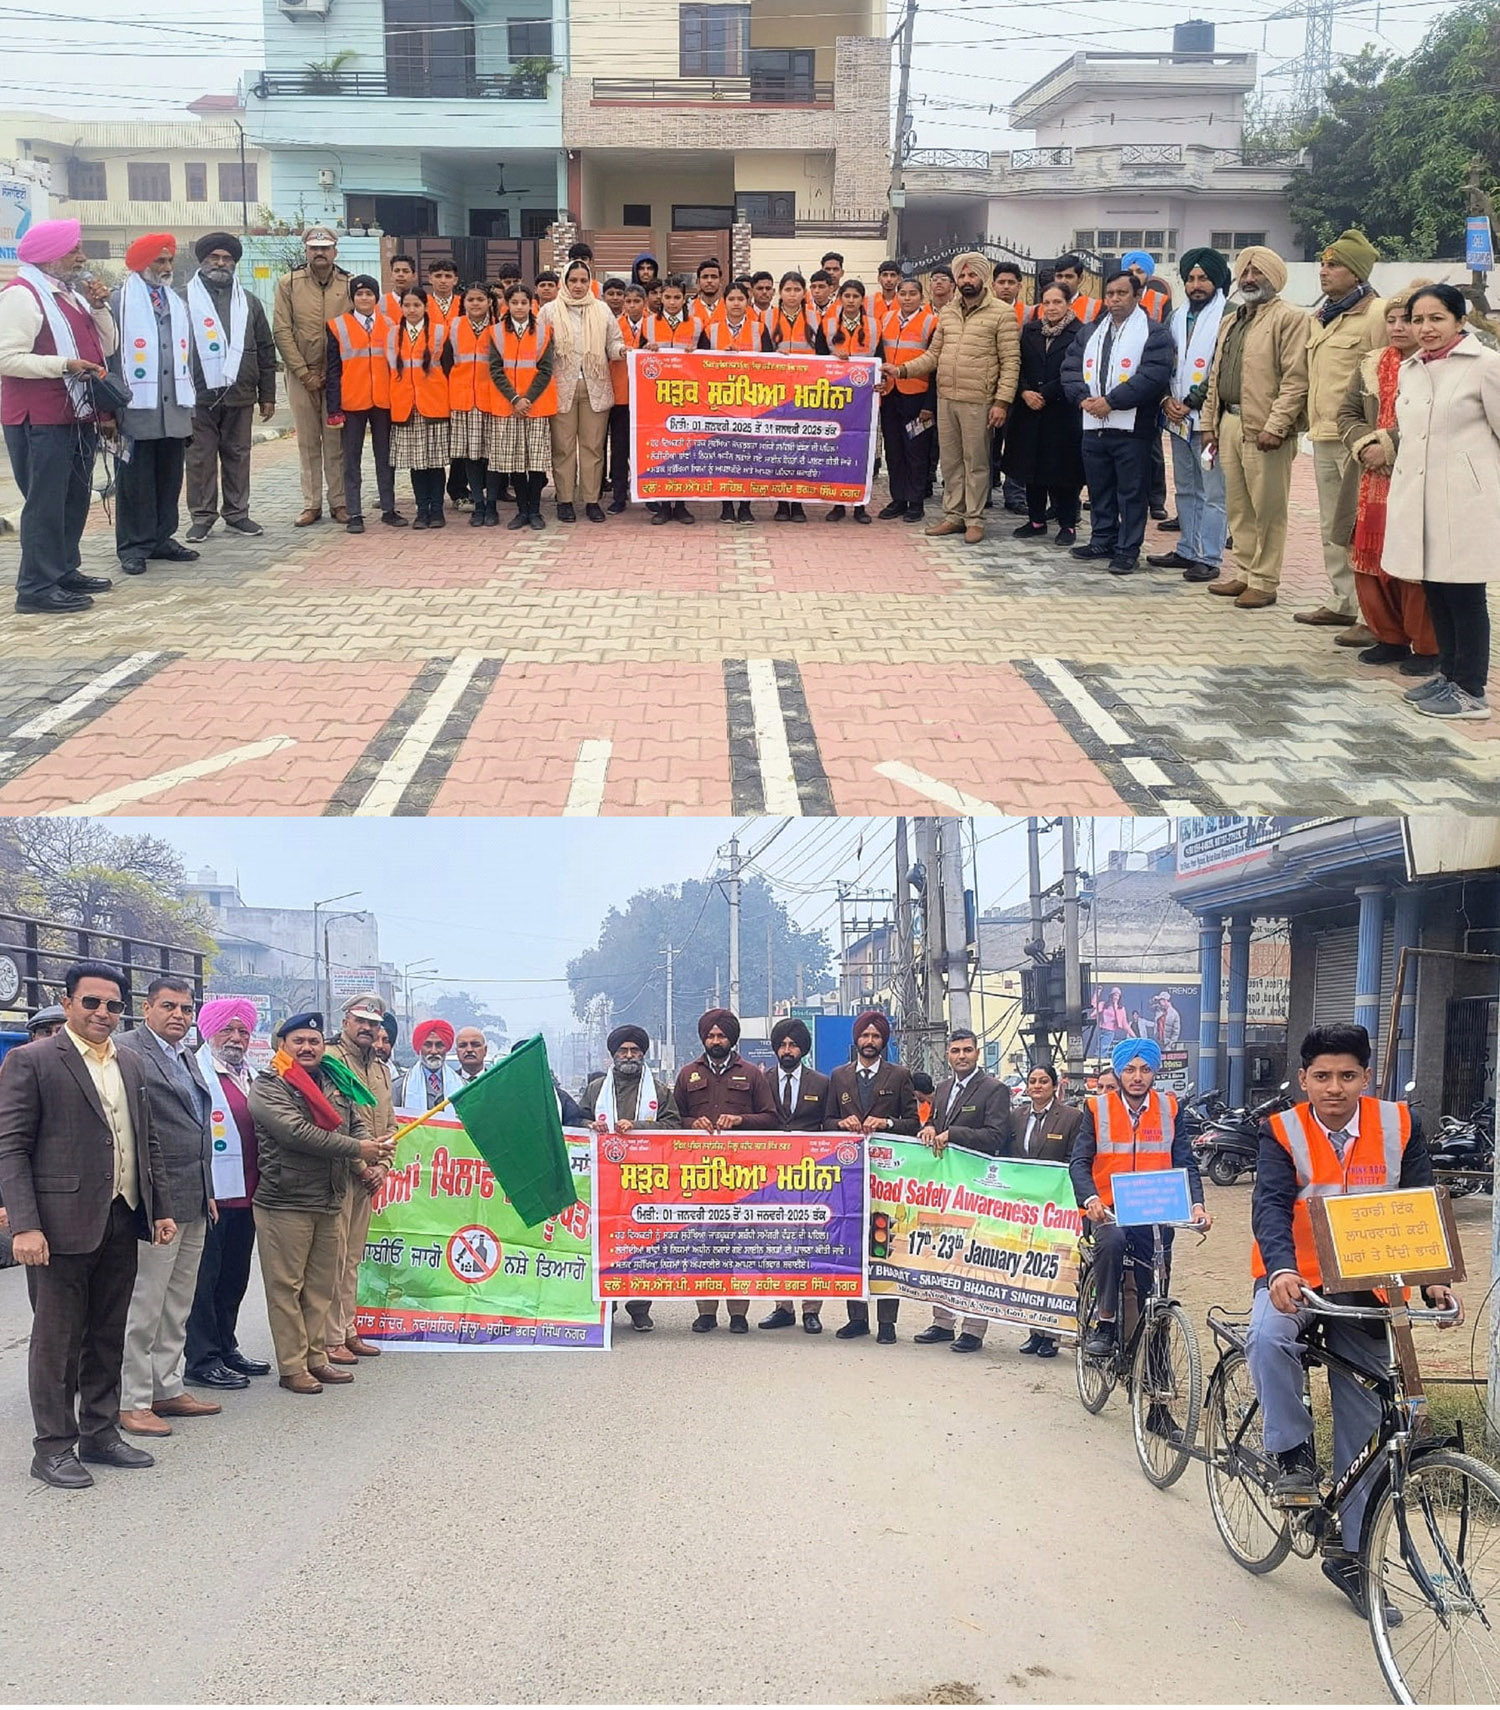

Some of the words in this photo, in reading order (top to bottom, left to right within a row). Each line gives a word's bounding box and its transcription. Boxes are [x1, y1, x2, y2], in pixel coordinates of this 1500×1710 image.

[656, 380, 698, 406] ਸੜਕ
[708, 375, 785, 411] ਸੁਰੱਖਿਆ
[794, 378, 853, 409] ਮਹੀਨਾ
[692, 421, 700, 430] 01
[733, 422, 752, 432] 2025
[802, 425, 822, 435] 2025
[1168, 987, 1198, 995] TRENDS
[620, 1163, 669, 1194] ਸੜਕ
[680, 1156, 767, 1197] ਸੁਰੱਖਿਆ
[777, 1156, 842, 1191] ਮਹੀਨਾ
[869, 1173, 903, 1203] Road
[906, 1177, 952, 1213] Safety
[952, 1184, 1039, 1227] Awareness
[636, 1206, 659, 1220] ਮਿਤੀ:
[662, 1209, 672, 1220] 01
[677, 1207, 705, 1220] ਜਨਵਰੀ
[708, 1209, 730, 1221] 2025
[743, 1209, 753, 1221] 31
[757, 1207, 784, 1220] ਜਨਵਰੀ
[788, 1209, 810, 1221] 2025
[813, 1208, 826, 1221] ਤੱਕ
[1352, 1202, 1386, 1221] ਤੁਹਾਡੀ
[1345, 1223, 1401, 1241] ਲਾਪਰਵਾਹੀ
[1406, 1220, 1429, 1236] ਕਈ
[410, 1242, 443, 1268] ਜਾਗੋ
[536, 1252, 586, 1281] ਤਿਆਗੋ
[964, 1239, 1022, 1279] January
[1022, 1250, 1060, 1280] 2025
[1343, 1249, 1366, 1263] ਘਰਾਂ
[1371, 1247, 1381, 1261] ਤੇ
[1415, 1241, 1441, 1256] ਭਾਰੀ
[695, 1277, 727, 1292] ਸਾਹਿਬ,
[784, 1280, 807, 1290] ਭਗਤ
[812, 1277, 831, 1290] ਸਿੰਘ
[834, 1281, 858, 1291] ਨਗਰ
[876, 1265, 911, 1284] BHARAT
[919, 1274, 961, 1291] SHAHEED
[963, 1281, 1008, 1300] BHAGAT
[1010, 1290, 1045, 1307] SINGH
[1047, 1296, 1078, 1313] NAGA
[1037, 1312, 1058, 1325] India
[515, 1324, 537, 1337] ਭਗਤ
[541, 1322, 561, 1338] ਸਿੰਘ
[564, 1326, 587, 1340] ਨਗਰ
[1335, 1444, 1370, 1496] AVON
